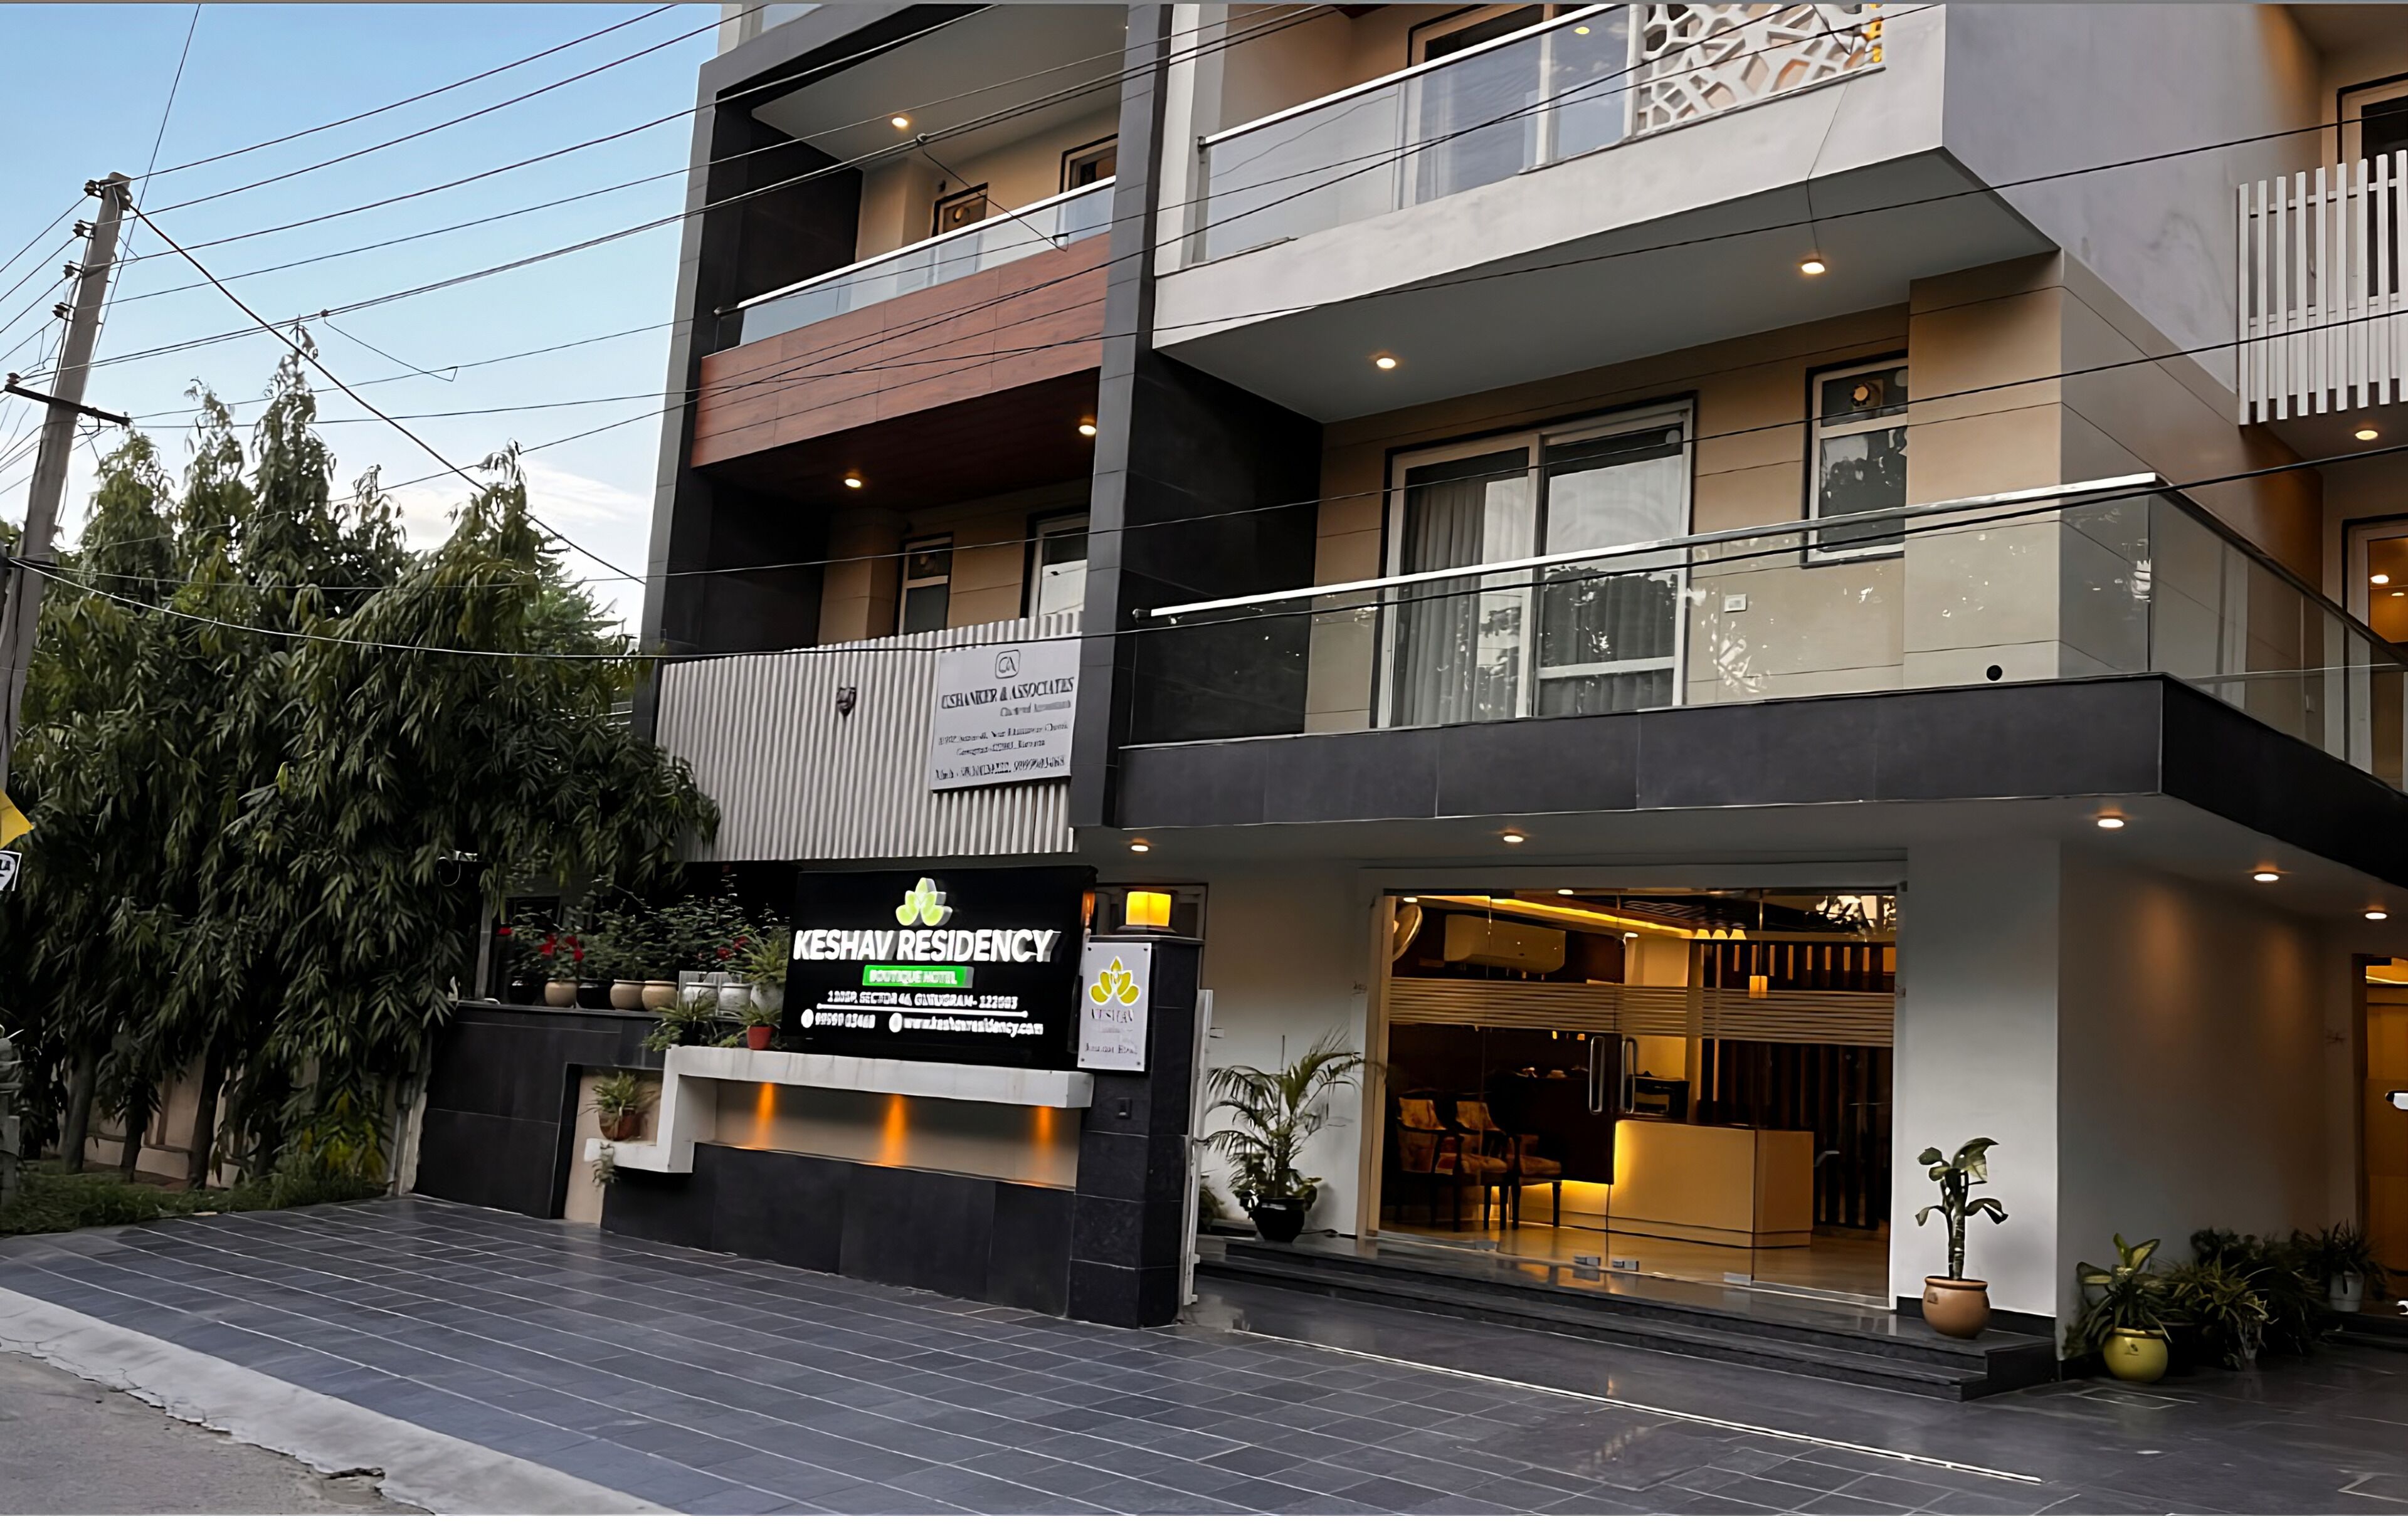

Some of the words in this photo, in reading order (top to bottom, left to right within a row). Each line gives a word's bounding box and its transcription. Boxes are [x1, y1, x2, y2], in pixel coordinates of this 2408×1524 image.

[1011, 678, 1074, 699] ASSOCIATES
[793, 929, 895, 961] KESHAV
[897, 929, 1059, 962] RESIDENCY
[869, 969, 922, 984] BOUTIQUE
[923, 970, 958, 985] HOTEL
[859, 991, 898, 1005] SECTOR
[904, 1016, 1043, 1038] www.keshavresidency.com
